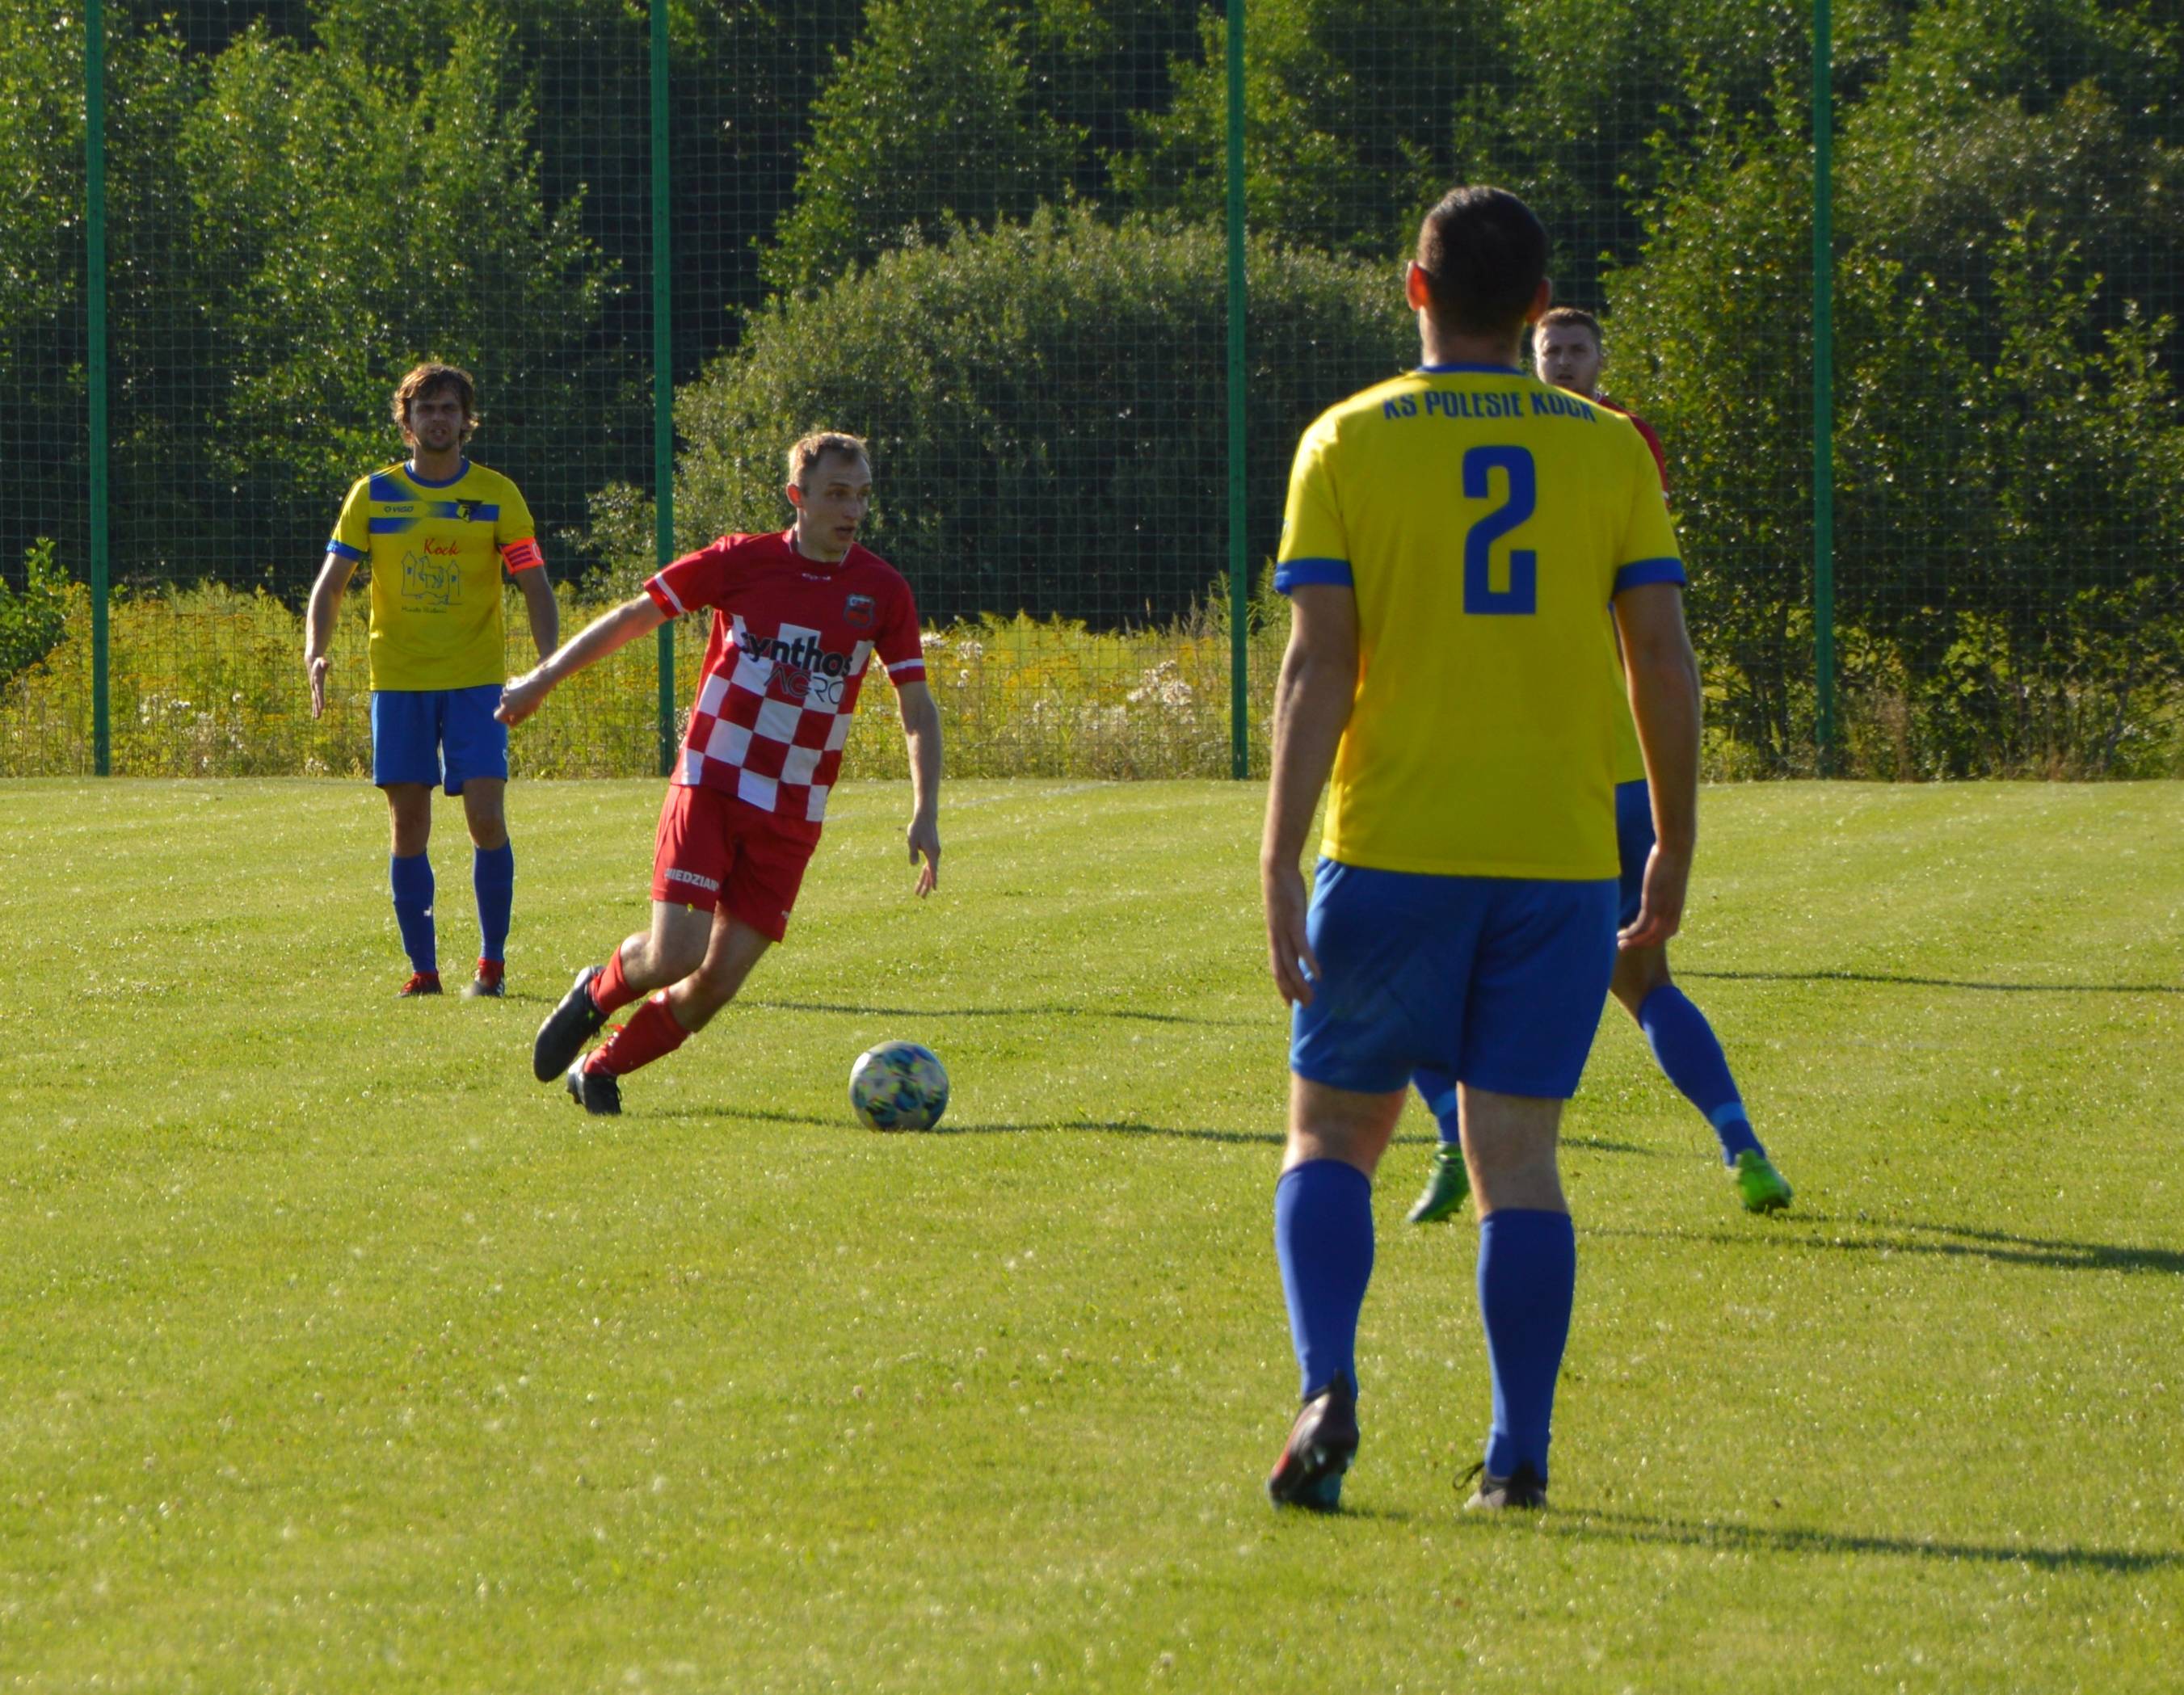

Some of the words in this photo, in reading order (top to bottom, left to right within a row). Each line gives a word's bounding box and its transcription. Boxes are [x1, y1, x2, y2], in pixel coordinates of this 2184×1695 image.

[1383, 394, 1416, 419] KS
[1424, 391, 1523, 418] POLESIE
[1530, 393, 1597, 423] KOCK
[423, 538, 459, 555] Kock
[1462, 445, 1537, 615] 2
[764, 666, 844, 704] AGRO
